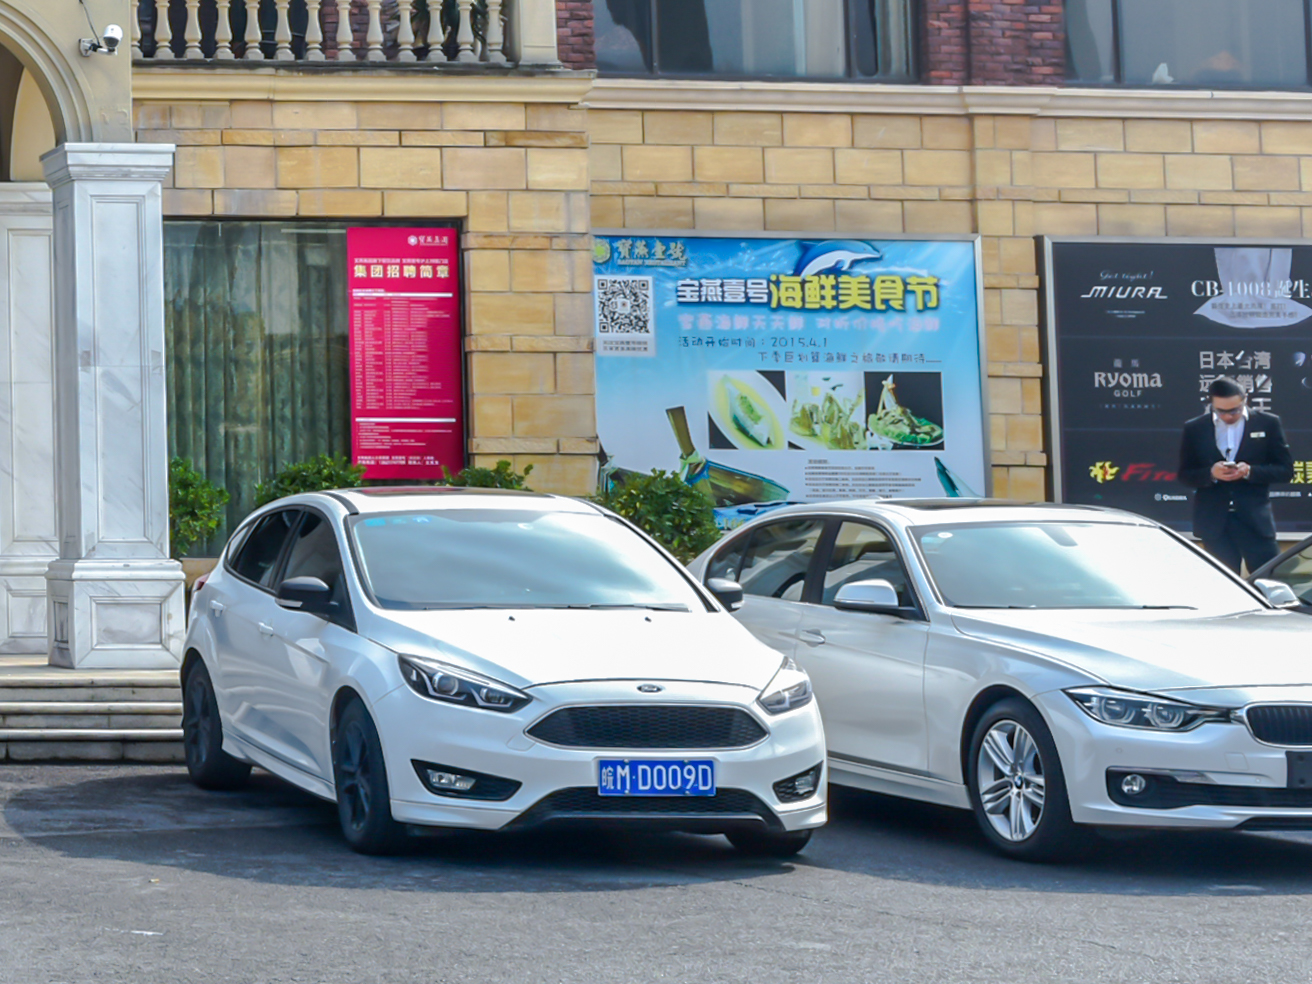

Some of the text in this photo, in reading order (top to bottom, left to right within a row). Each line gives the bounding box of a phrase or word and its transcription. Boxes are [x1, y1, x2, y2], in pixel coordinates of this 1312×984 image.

[1080, 286, 1168, 299] MIURA
[1094, 371, 1163, 388] Ryoma
[1113, 389, 1143, 398] GOLF
